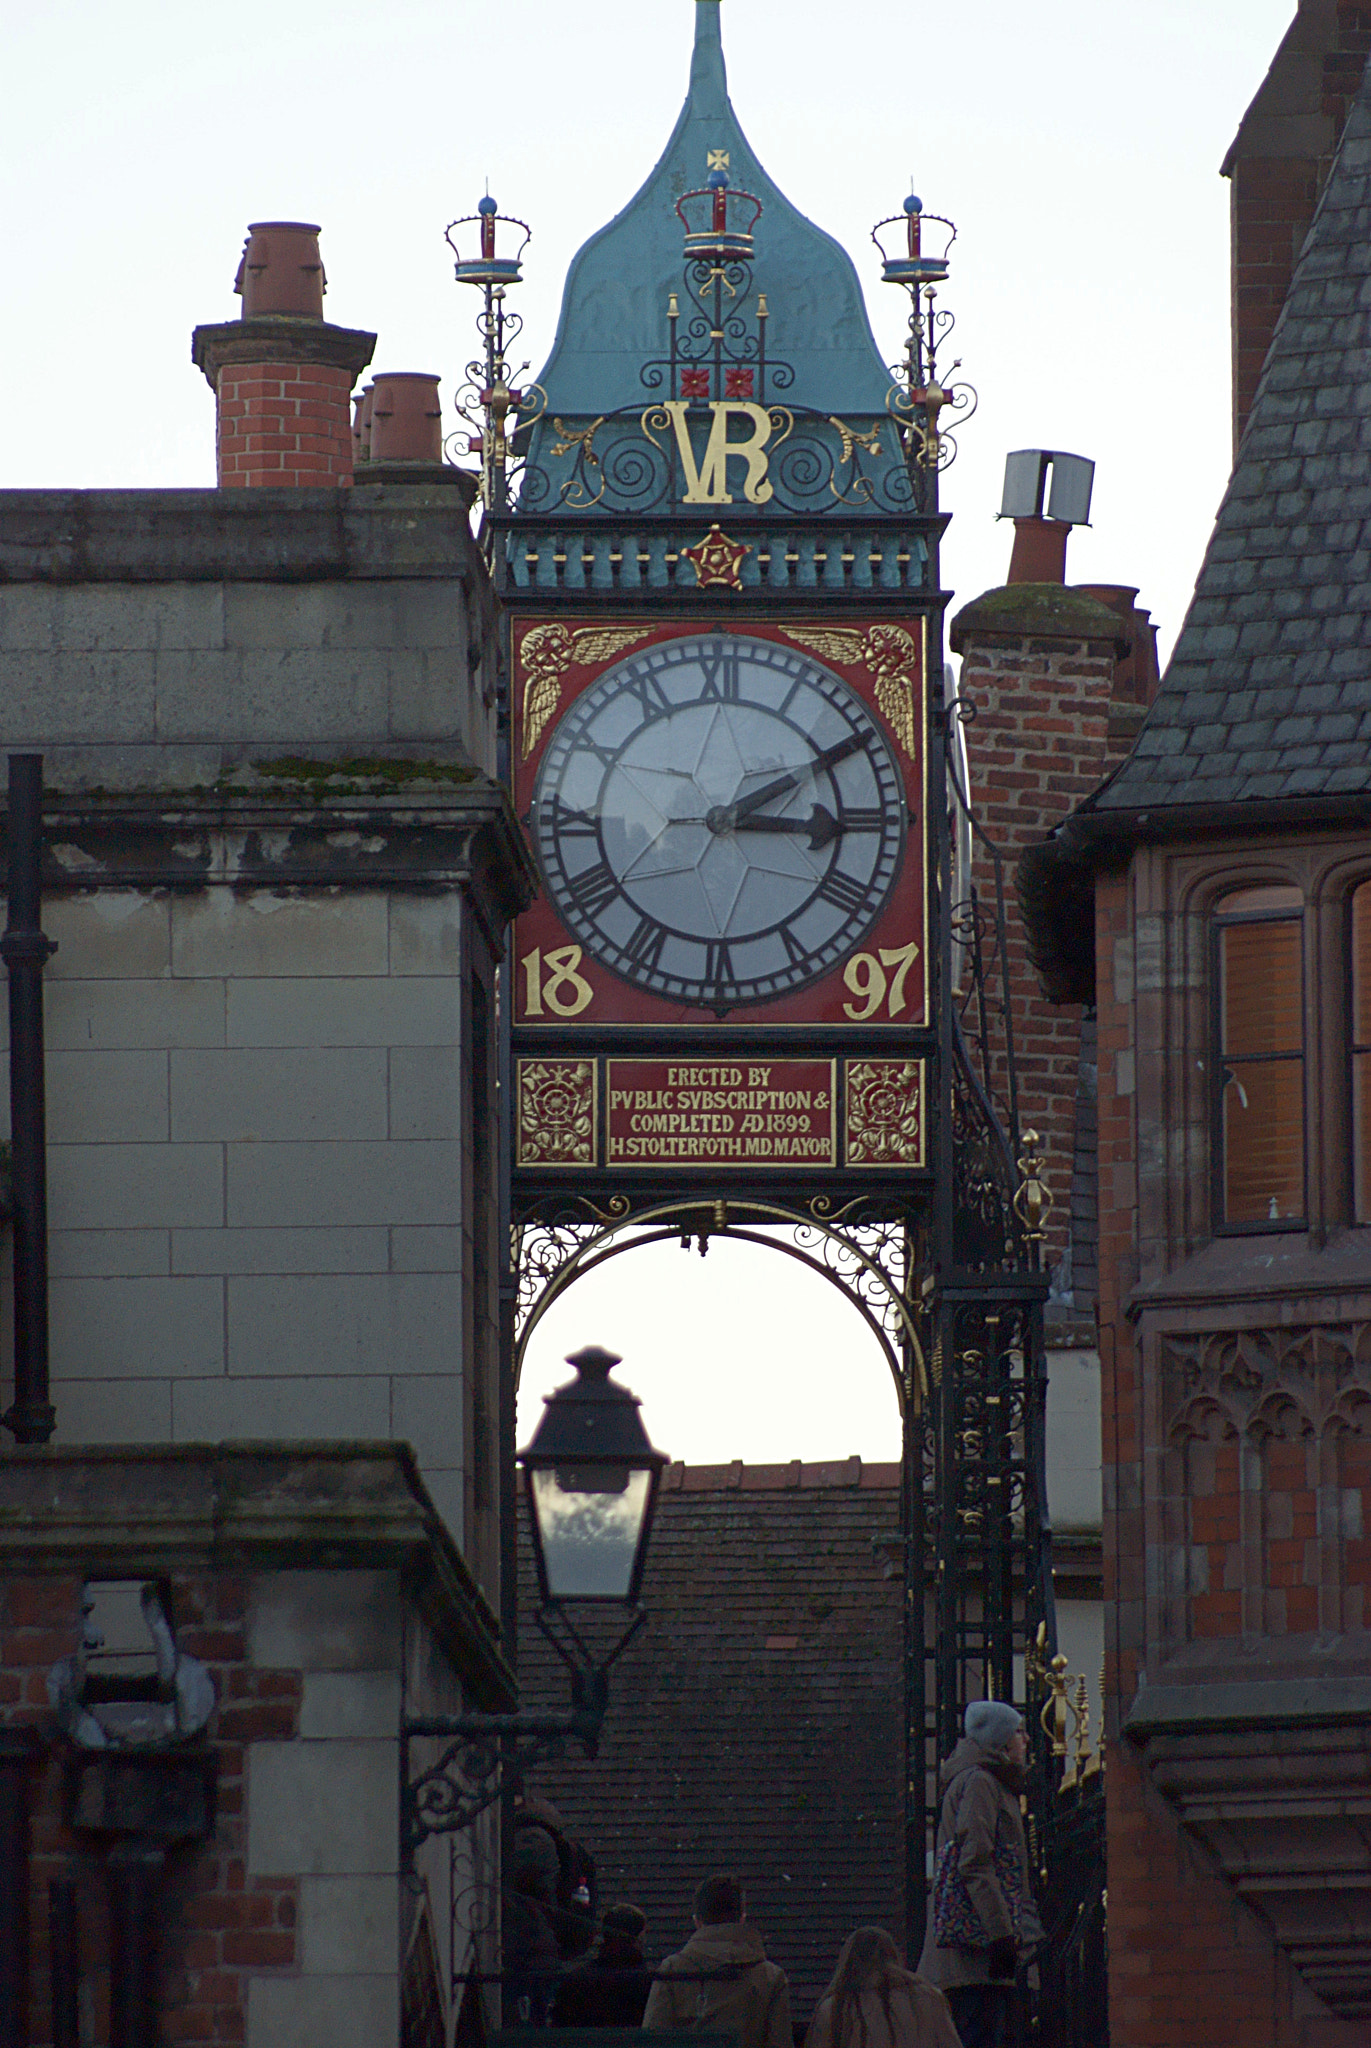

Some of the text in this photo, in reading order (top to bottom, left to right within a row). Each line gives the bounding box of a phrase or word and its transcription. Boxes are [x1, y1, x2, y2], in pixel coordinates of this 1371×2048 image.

[664, 401, 774, 504] VR
[622, 671, 672, 722] XI
[699, 659, 740, 701] XII
[556, 802, 600, 838] IX
[841, 807, 884, 833] III
[568, 861, 620, 921] VIII
[622, 917, 668, 971] VII
[704, 940, 736, 983] VI
[521, 945, 594, 1017] 18
[842, 941, 920, 1020] 97
[667, 1067, 772, 1086] ERECTED BY
[610, 1090, 831, 1110] PVBLIC SVBSCRIPTION &
[630, 1113, 735, 1133] COMPLETED
